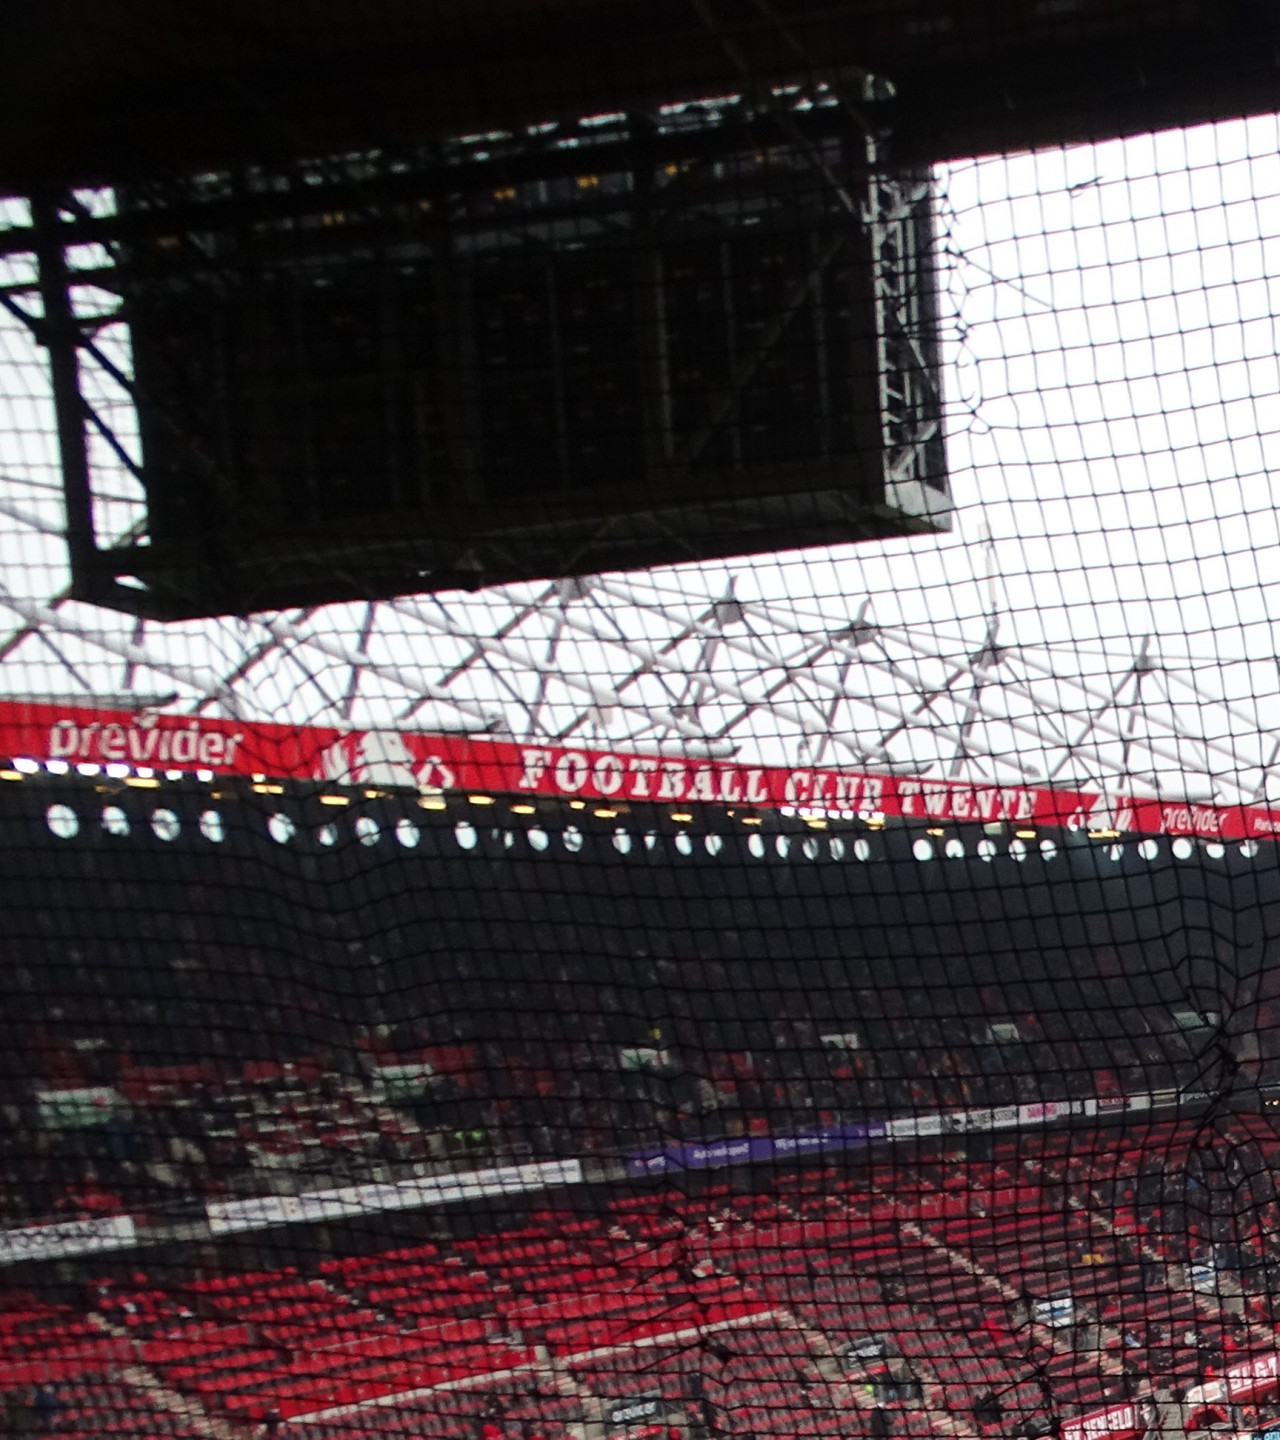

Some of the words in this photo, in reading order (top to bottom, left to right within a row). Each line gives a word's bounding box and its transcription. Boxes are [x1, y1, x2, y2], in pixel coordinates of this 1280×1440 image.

[50, 712, 244, 765] previder
[518, 749, 768, 803] FOOTBALL
[785, 771, 884, 811] CLUB
[900, 780, 1038, 820] TWENTE
